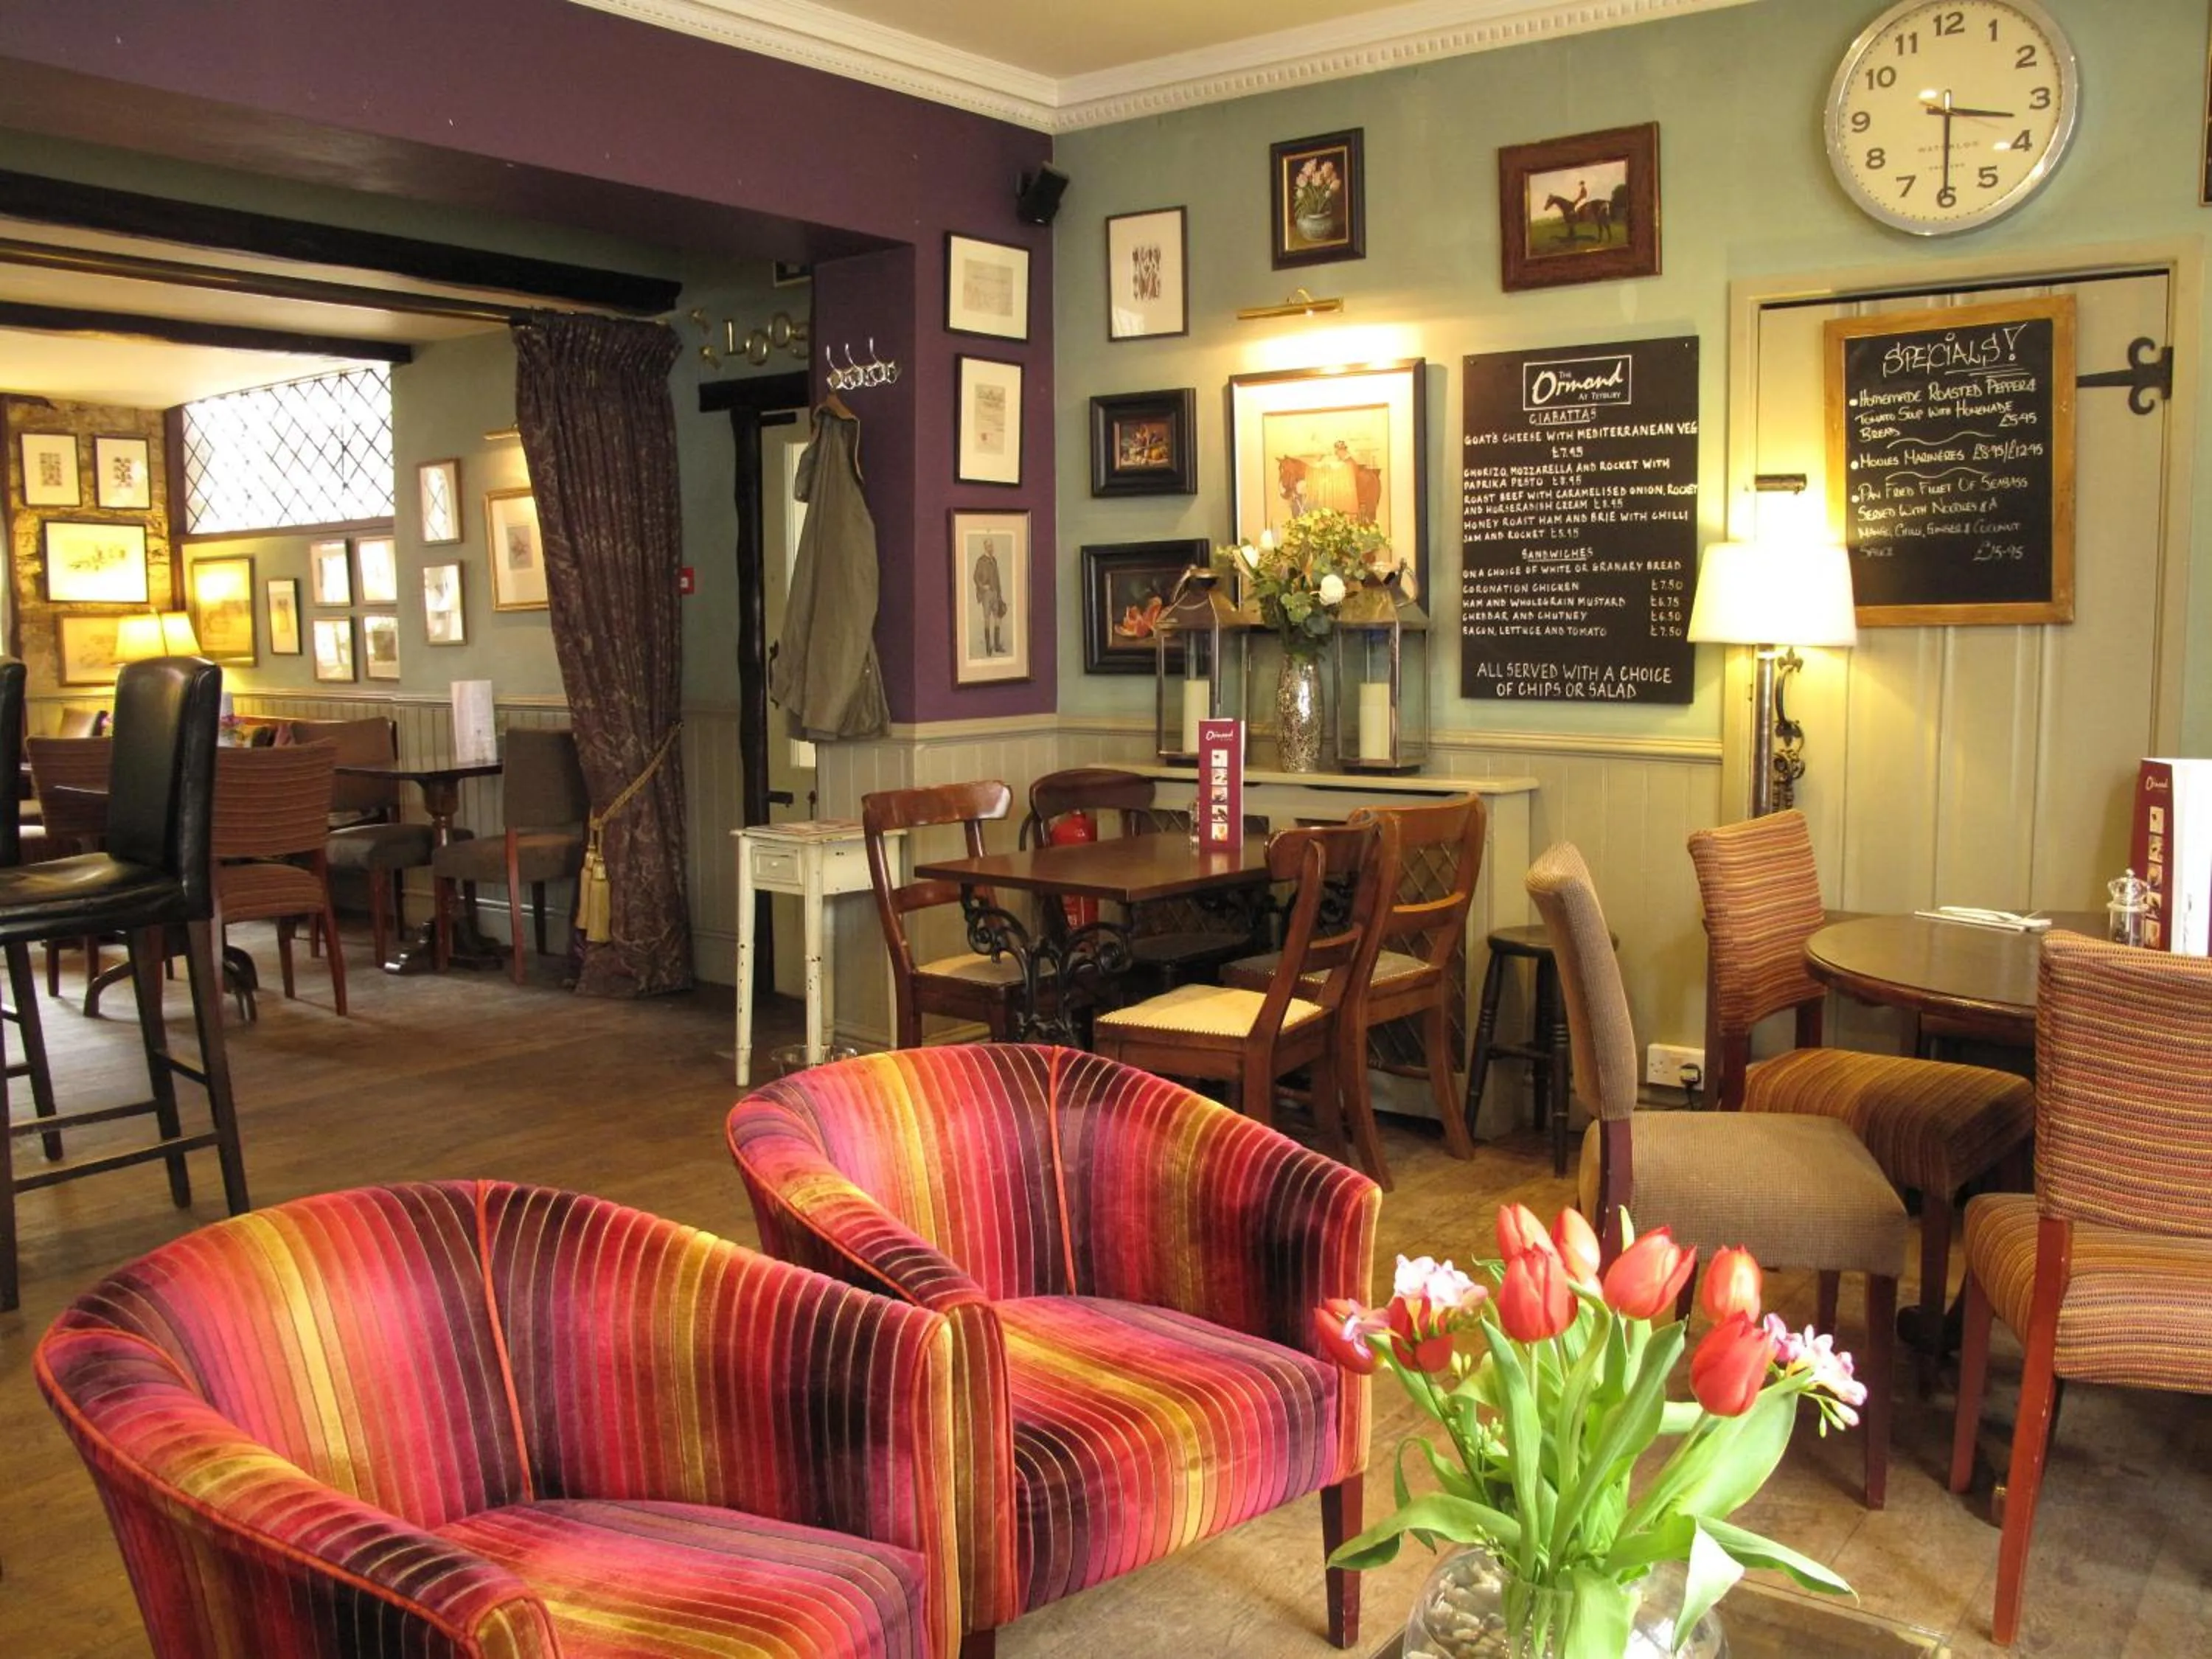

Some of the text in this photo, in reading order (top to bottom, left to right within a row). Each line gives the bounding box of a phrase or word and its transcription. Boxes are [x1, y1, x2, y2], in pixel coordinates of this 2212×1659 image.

[1933, 11, 1965, 37] 12
[1989, 18, 1998, 42] 1
[1895, 32, 1918, 56] 11
[2015, 44, 2037, 69] 2
[1865, 66, 1896, 90] 10
[2029, 87, 2051, 110] 3
[1851, 111, 1871, 133] 9
[2009, 129, 2033, 152] 4
[1865, 147, 1886, 170] 8
[1896, 175, 1916, 198] 7
[1978, 165, 1999, 189] 5
[1936, 186, 1957, 209] 6
[1532, 361, 1623, 404] Ormond
[1502, 431, 1542, 442] CHEESE
[1546, 430, 1574, 441] WITH
[1577, 422, 1674, 440] MEDITERRANEAN
[1510, 463, 1573, 476] MOZZARELLA
[1576, 462, 1596, 473] AND
[1599, 460, 1638, 471] ROCKET
[1642, 458, 1670, 469] WITH
[1464, 479, 1507, 490] PAPRIKA
[1464, 493, 1495, 504] ROAST
[1499, 491, 1525, 501] BEEF
[1527, 490, 1553, 500] WITH
[1555, 486, 1627, 498] CARAMELISED
[1464, 506, 1484, 515] AND
[1464, 518, 1500, 530] HONEY
[1502, 516, 1535, 526] ROAST
[1539, 515, 1562, 525] HAM
[1565, 513, 1587, 524] AND
[1590, 511, 1616, 523] BRIE
[1620, 512, 1648, 521] WITH
[1464, 534, 1481, 543] JAM
[1484, 531, 1504, 540] AND
[1508, 529, 1545, 539] ROCKET
[1521, 547, 1593, 560] SANDWICHES
[1487, 566, 1521, 577] CHOICE
[1525, 565, 1538, 574] OF
[1540, 564, 1571, 574] WHITE
[1574, 564, 1589, 573] OR
[1646, 560, 1682, 571] BREAD
[1462, 582, 1579, 594] CORONATION CHICKEN
[1462, 598, 1484, 608] HAM
[1486, 598, 1506, 607] AND
[1577, 597, 1626, 608] MUSTARD
[1462, 611, 1587, 622] CHEDDAR AND CHUTNEY
[1499, 625, 1542, 635] LETTUCE
[1544, 626, 1565, 635] AND
[1568, 626, 1607, 636] TOMATO
[1476, 662, 1673, 684] ALL SERVED WITH A CHOICE
[1496, 681, 1637, 699] OF CHIPS OR SALAD
